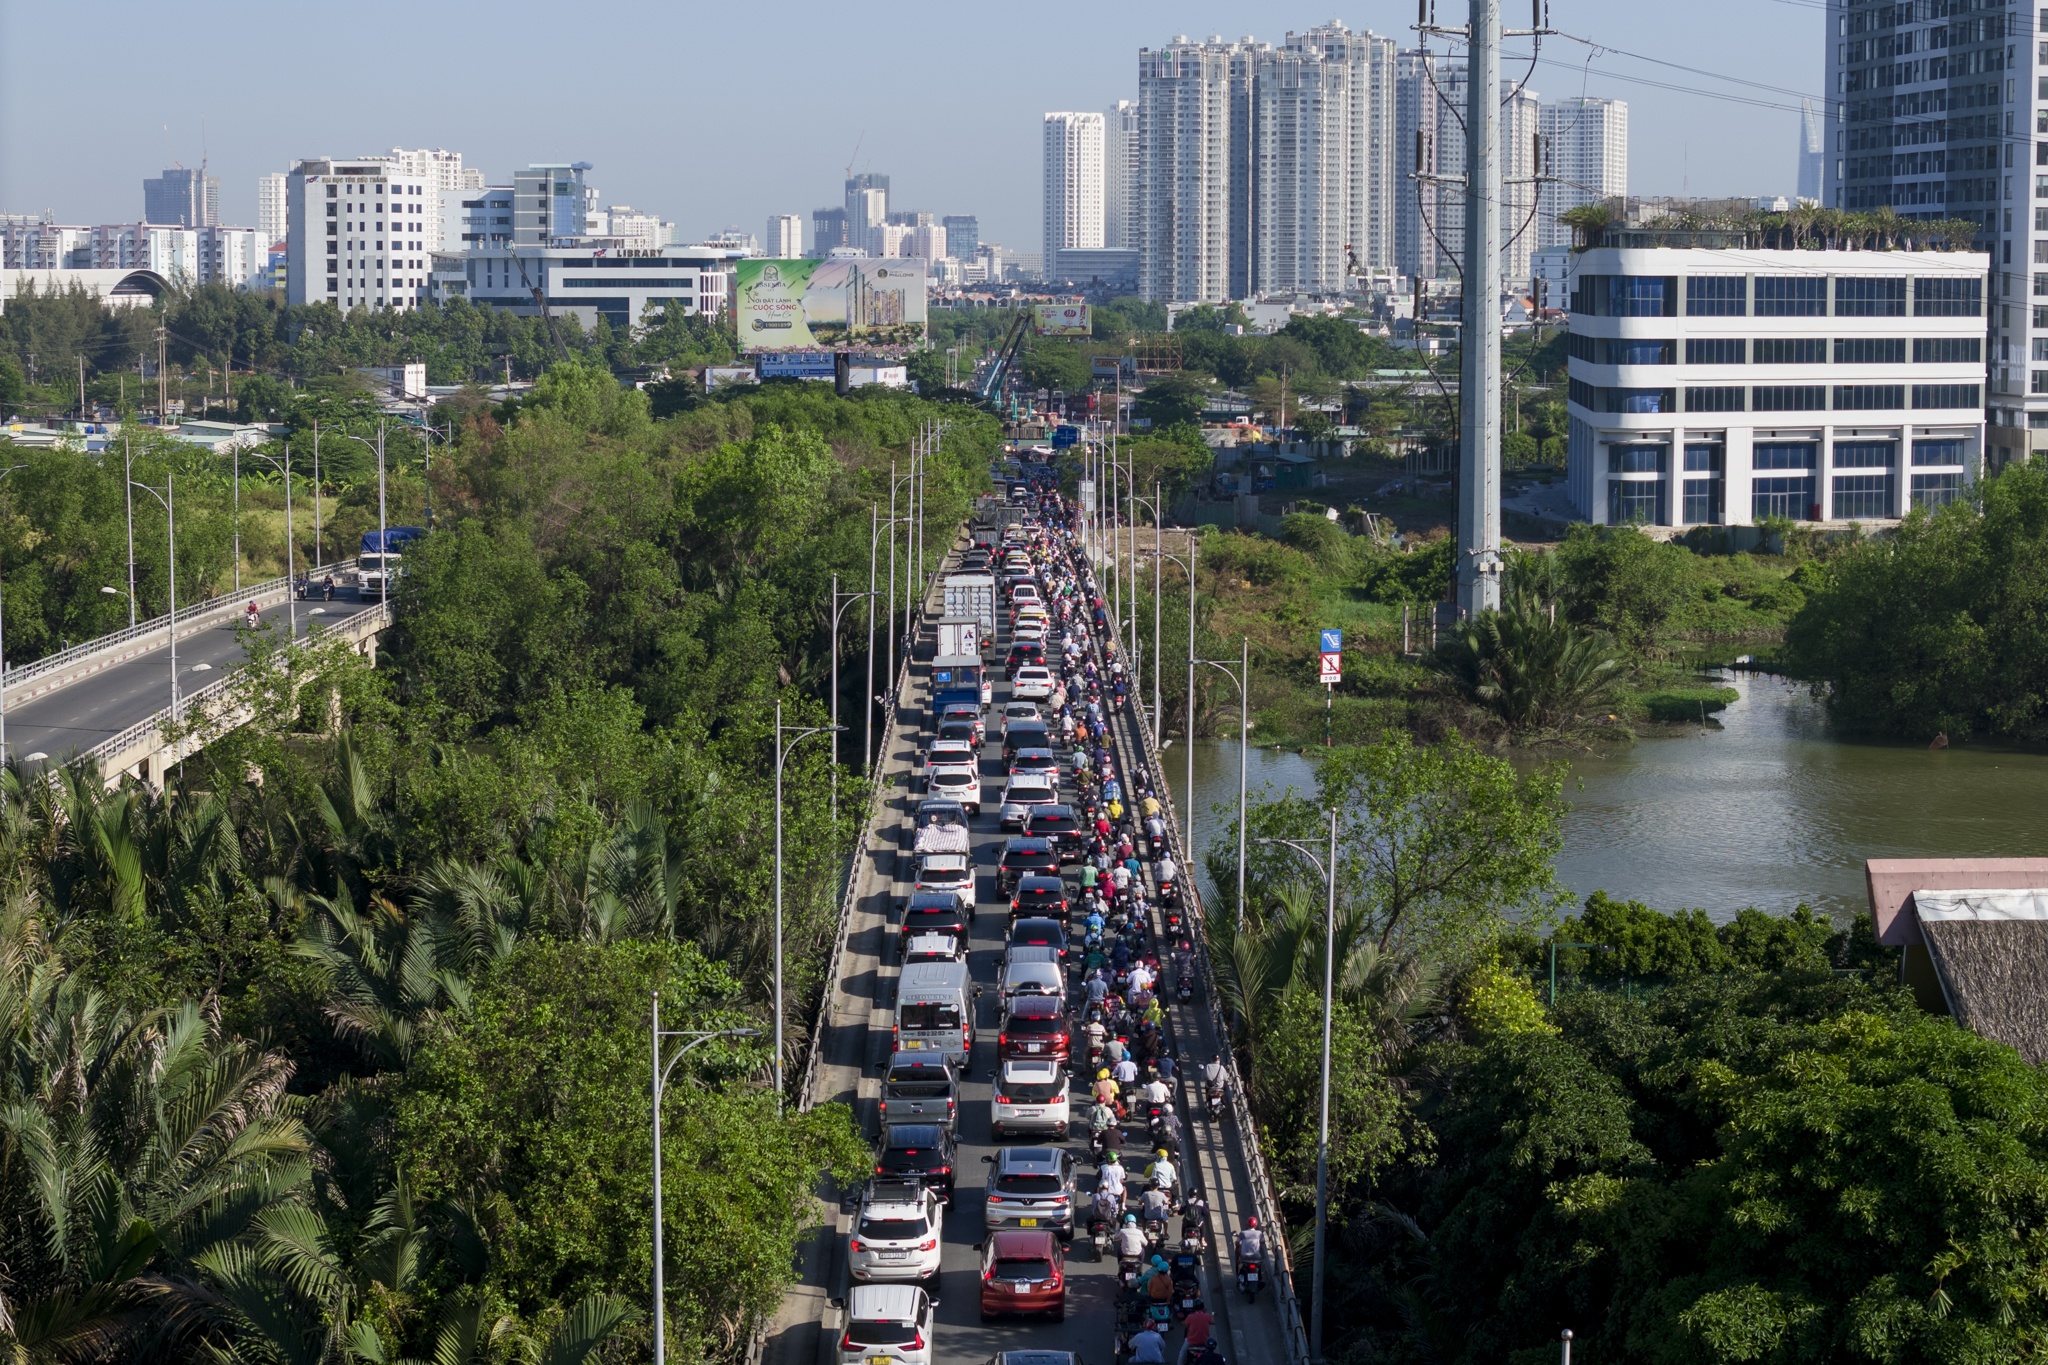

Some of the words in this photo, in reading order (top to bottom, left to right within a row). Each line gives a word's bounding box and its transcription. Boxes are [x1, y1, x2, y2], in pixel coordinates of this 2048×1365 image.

[616, 249, 664, 258] LIBRARY
[753, 303, 774, 311] CUỘC
[775, 302, 797, 311] SỐNG
